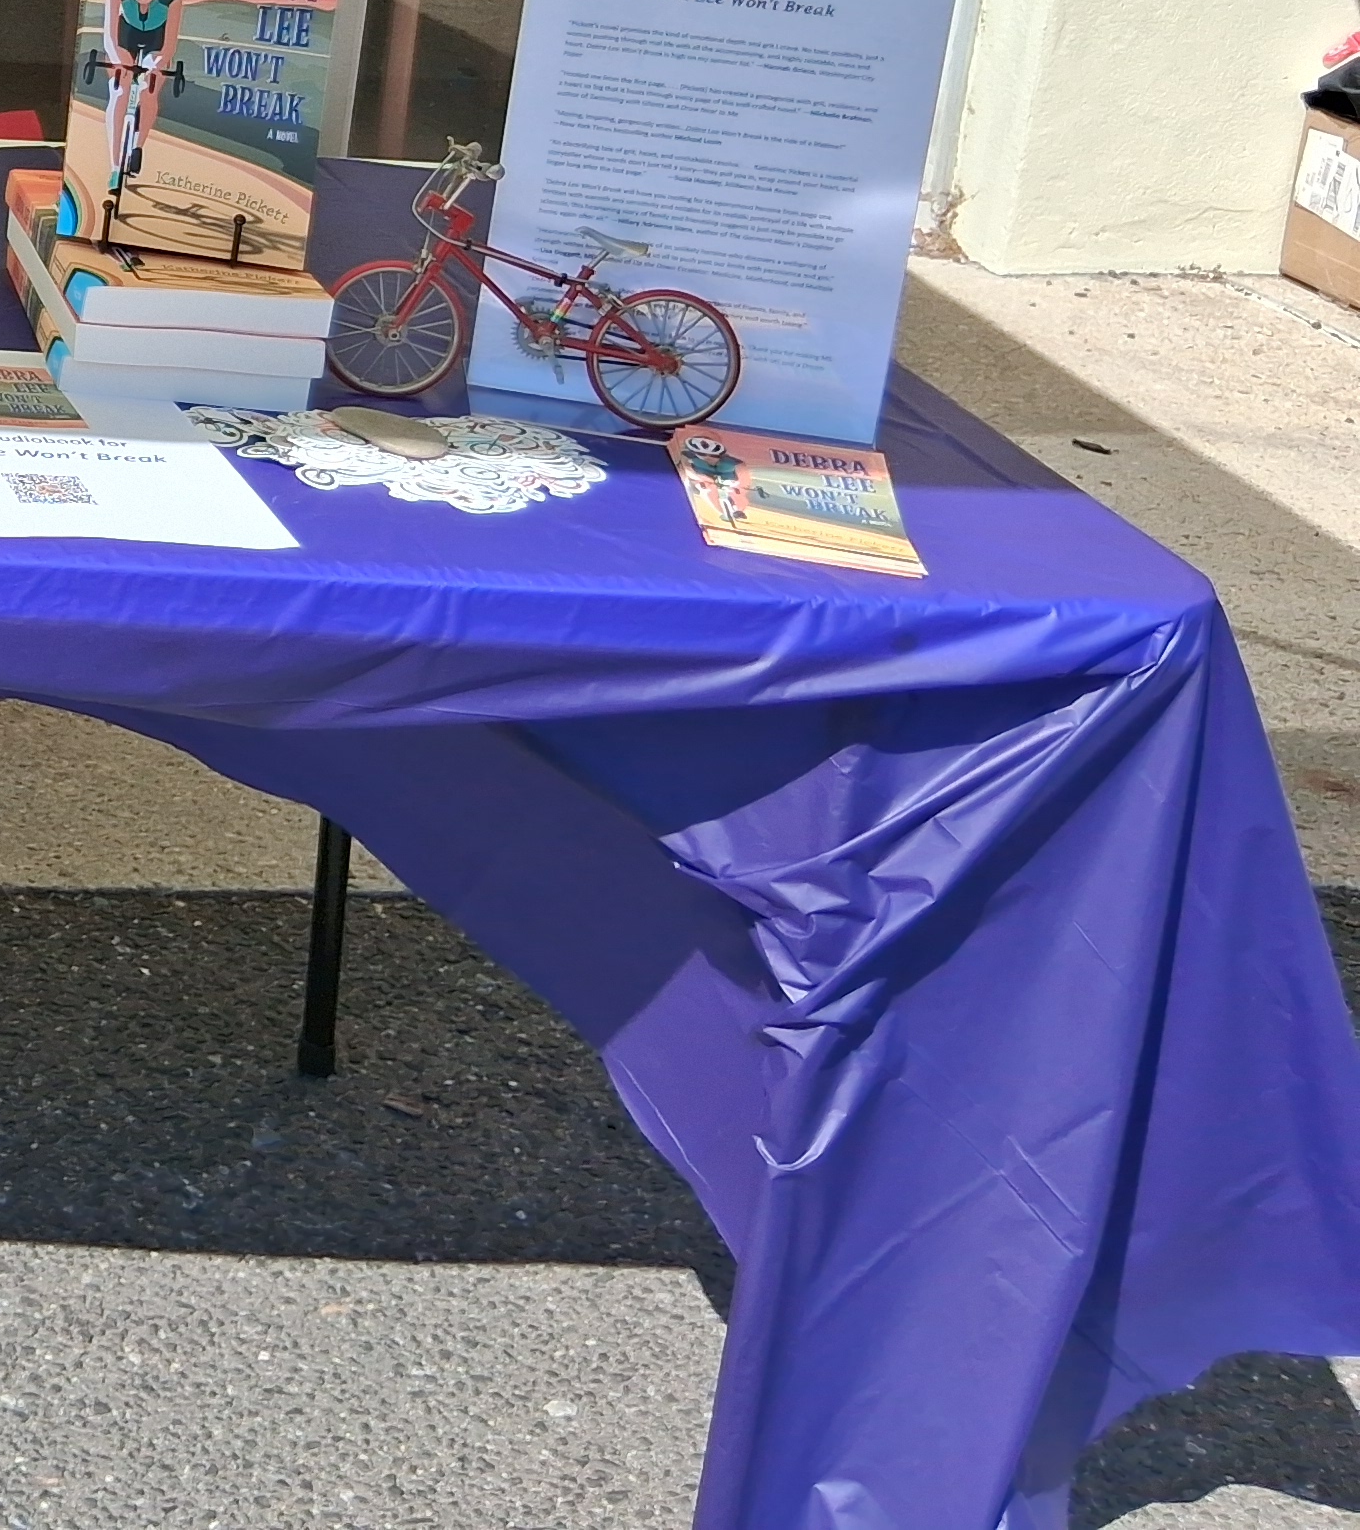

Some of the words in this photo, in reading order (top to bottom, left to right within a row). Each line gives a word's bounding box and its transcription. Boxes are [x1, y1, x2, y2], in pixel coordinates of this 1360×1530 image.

[782, 0, 836, 17] Break
[253, 5, 313, 49] LEE
[202, 45, 284, 84] WON'T
[217, 82, 305, 124] BREAK
[267, 129, 273, 139] A
[276, 130, 298, 143] NOVEL
[155, 170, 232, 200] Katherine
[235, 192, 290, 225] Pickett
[12, 382, 50, 394] LEE
[7, 403, 67, 414] BREAK
[98, 438, 128, 448] for
[15, 448, 88, 460] Won't
[97, 452, 168, 463] Break
[769, 448, 871, 476] DEBRA
[780, 484, 858, 504] WON'T
[820, 474, 877, 494] LEE
[805, 498, 891, 521] BREAK
